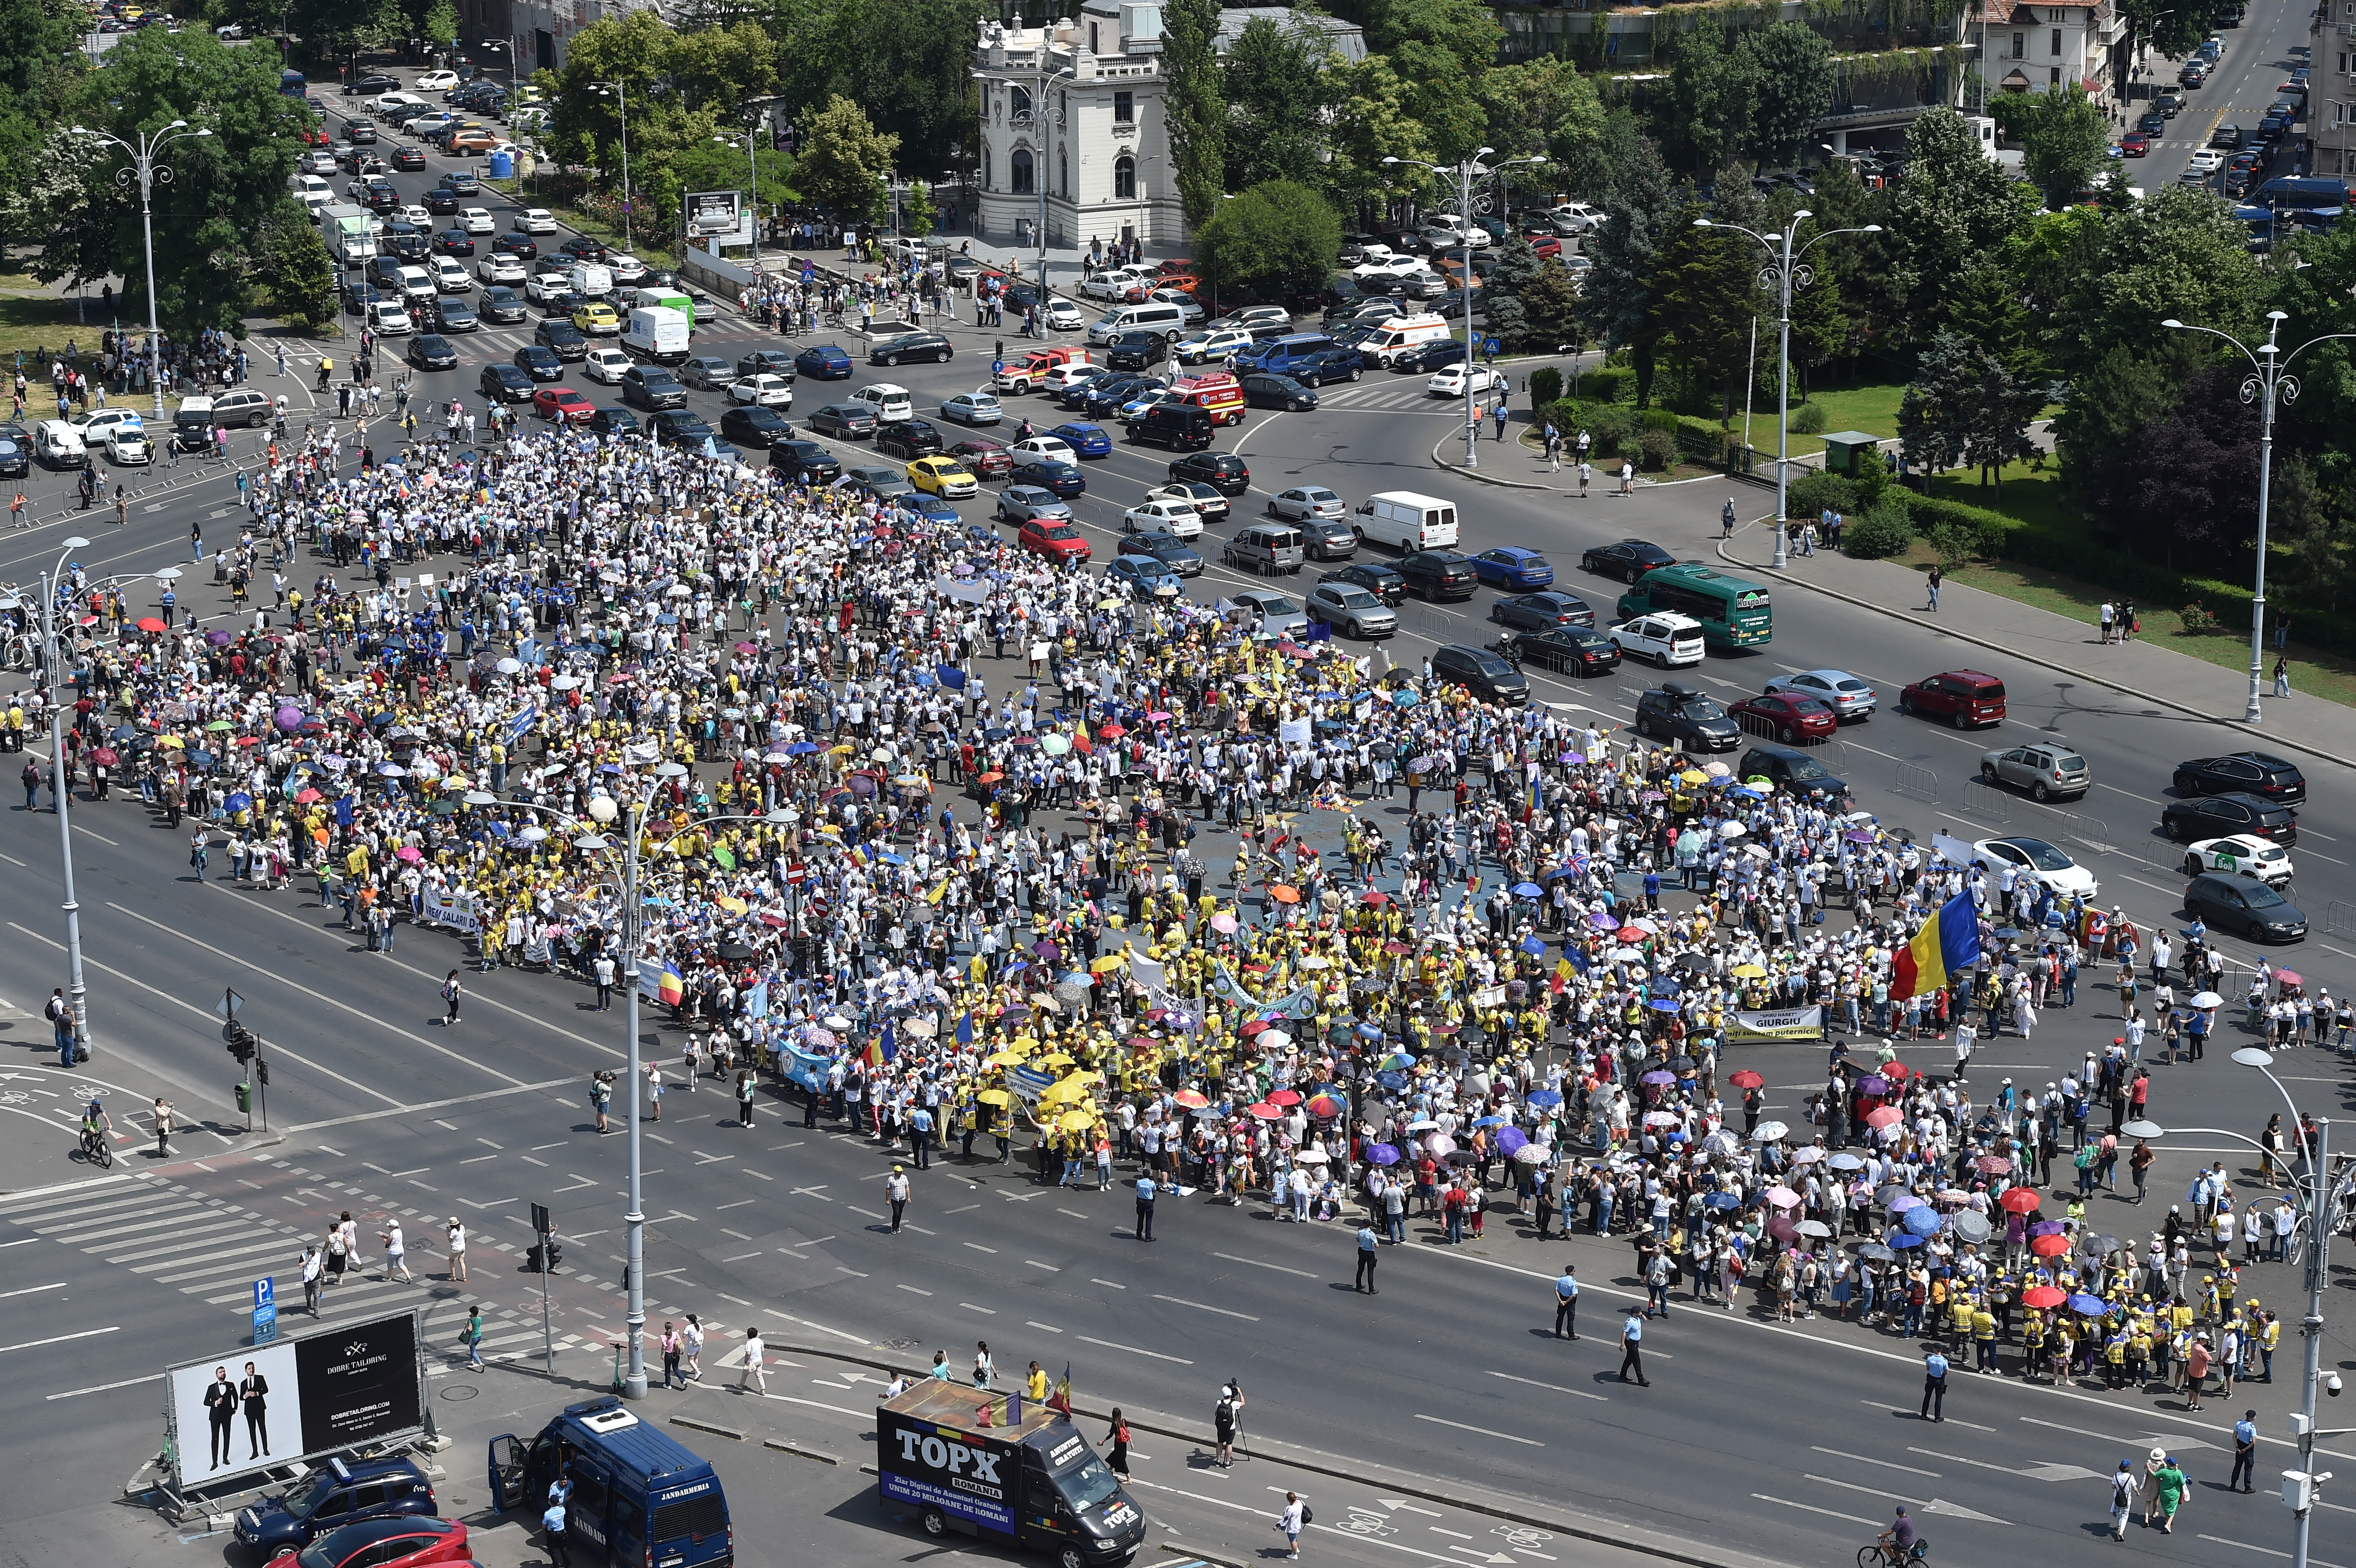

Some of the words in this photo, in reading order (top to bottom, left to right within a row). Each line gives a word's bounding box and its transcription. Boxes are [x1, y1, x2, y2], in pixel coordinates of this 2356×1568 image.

[846, 235, 854, 243] M
[1737, 595, 1770, 608] Karpaten
[2218, 858, 2233, 872] Bolt
[425, 904, 442, 920] VREM
[442, 911, 468, 927] SALARII
[1756, 1018, 1800, 1027] GIURGIU
[1775, 1028, 1815, 1037] puternici!
[1010, 1081, 1027, 1091] SPIRU
[258, 1279, 268, 1303] P
[327, 1363, 349, 1374] DOBRE
[351, 1354, 387, 1369] TAILORING
[331, 1401, 390, 1420] DOBRETAILORING.COM
[896, 1428, 1001, 1484] TOPX
[1049, 1435, 1080, 1459] ANUNTURI
[1055, 1445, 1083, 1466] GRATUITE
[661, 1482, 710, 1501] JANDARMERIA
[894, 1476, 909, 1485] Ziar
[909, 1480, 932, 1493] Digital
[933, 1487, 942, 1495] de
[943, 1490, 973, 1503] Anunturi
[974, 1497, 1002, 1512] Gratuite
[954, 1479, 1001, 1498] ROMANIA
[889, 1483, 910, 1495] UNIM
[911, 1490, 921, 1498] 20
[922, 1492, 962, 1509] MILIOANE
[963, 1504, 974, 1513] DE
[975, 1507, 1009, 1523] ROMANI
[1102, 1504, 1136, 1529] TOPX
